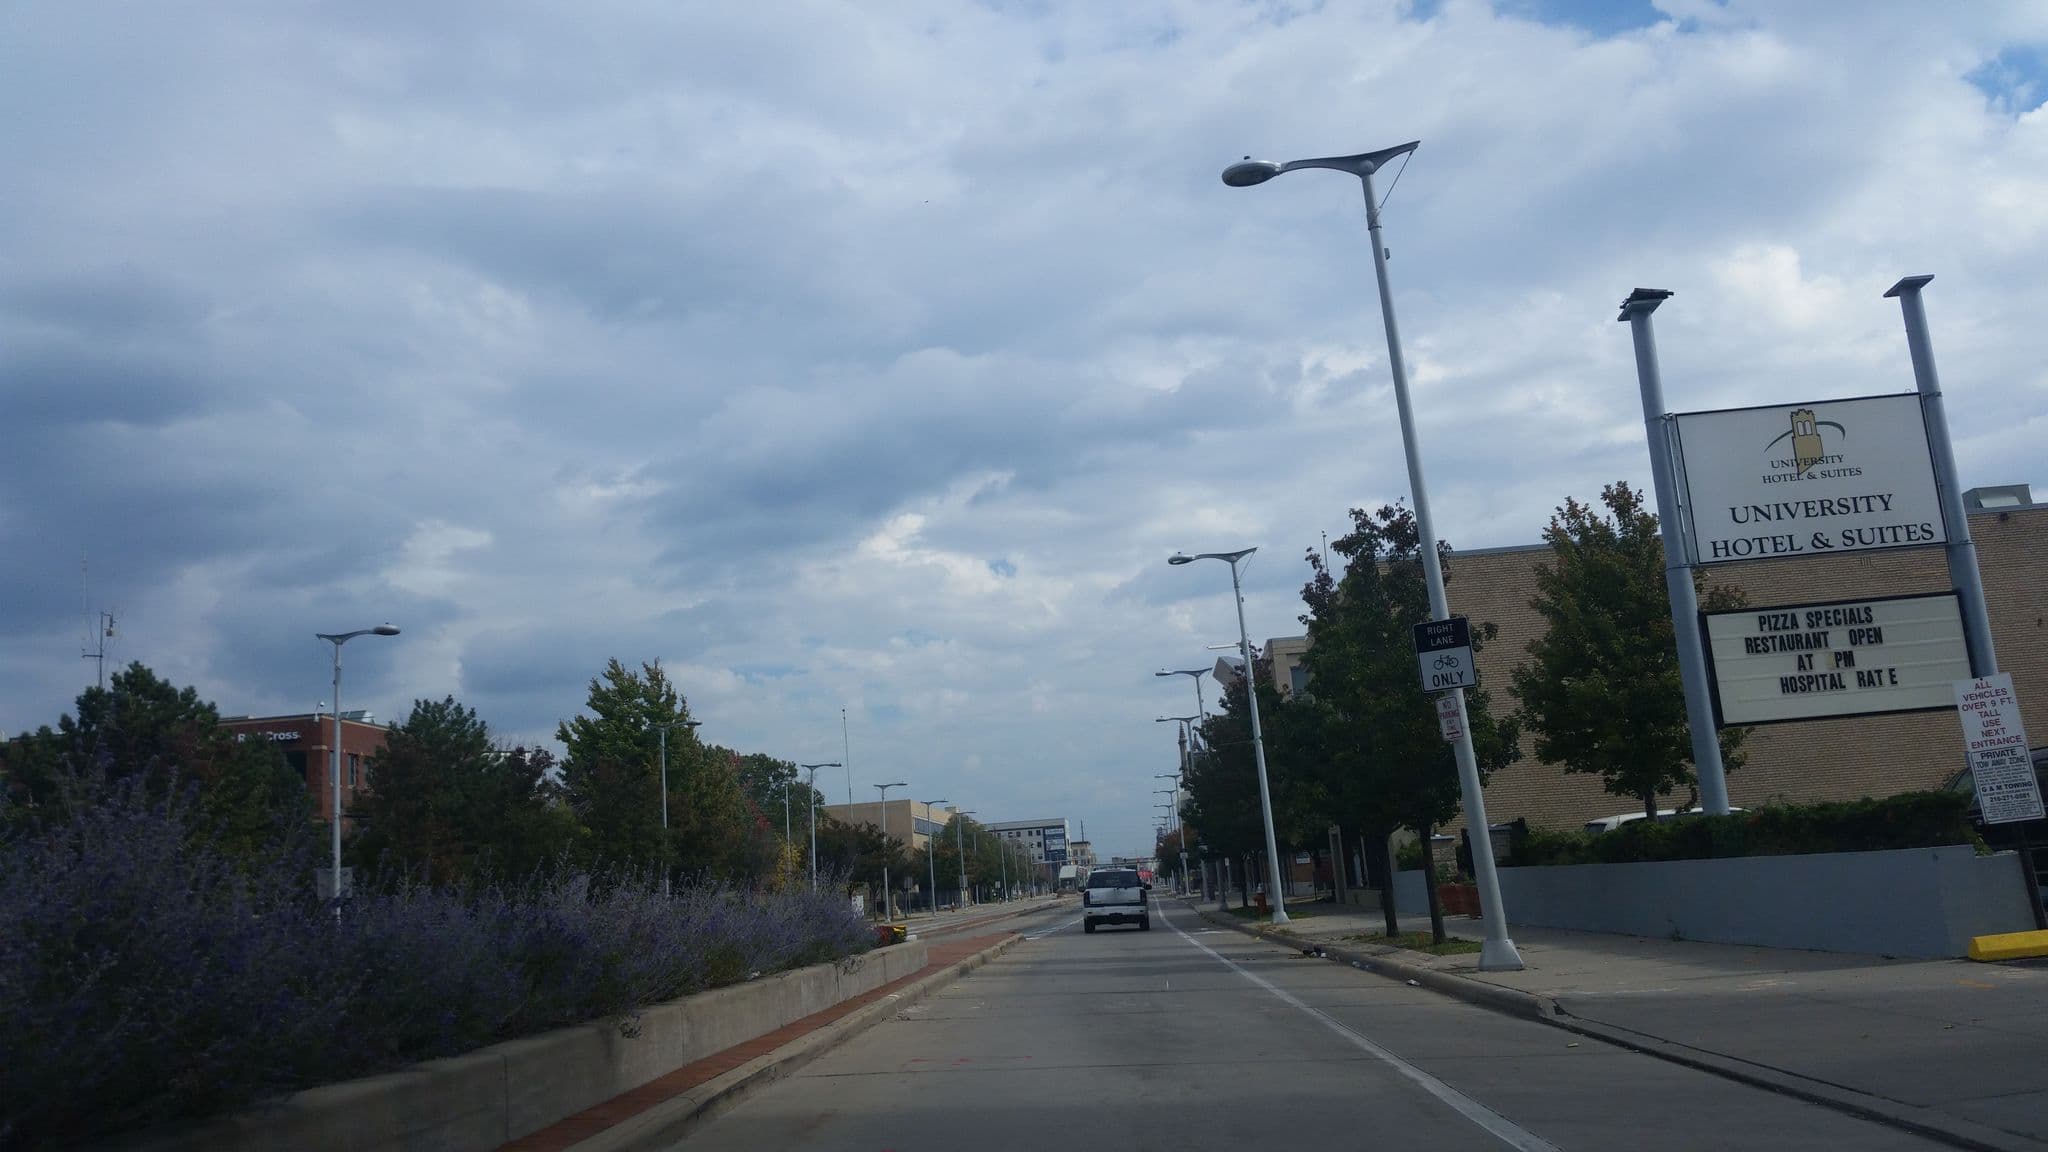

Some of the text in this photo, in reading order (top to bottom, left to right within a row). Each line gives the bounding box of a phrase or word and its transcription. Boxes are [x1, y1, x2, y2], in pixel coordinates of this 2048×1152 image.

[1770, 454, 1844, 469] UNIVERSITY
[1762, 467, 1863, 484] HOTEL & SUITES
[1730, 493, 1894, 524] UNIVERSITY
[1710, 522, 1935, 559] HOTEL & SUITES
[1758, 606, 1873, 632] PIZZA SPECIALS
[1427, 623, 1455, 635] RIGHT
[1431, 635, 1455, 647] LANE
[1744, 627, 1883, 654] RESTAURANT OPEN
[1797, 650, 1856, 671] AT PM
[1432, 670, 1464, 688] ONLY
[1780, 672, 1846, 694] HOSPITAL
[1974, 681, 1992, 690] ALL
[1963, 688, 2008, 701] VEHICLES
[1962, 697, 2014, 712] OVER 9 FT.
[1978, 710, 2001, 719] TALL
[1982, 718, 2001, 728] USE
[1981, 727, 2006, 738] NEXT
[1971, 735, 2022, 749] ENTRANCE
[1980, 749, 2017, 760] PRIVATE
[1976, 760, 1990, 769] TOW
[2009, 755, 2026, 765] ZONE
[2004, 781, 2033, 790] TOWING
